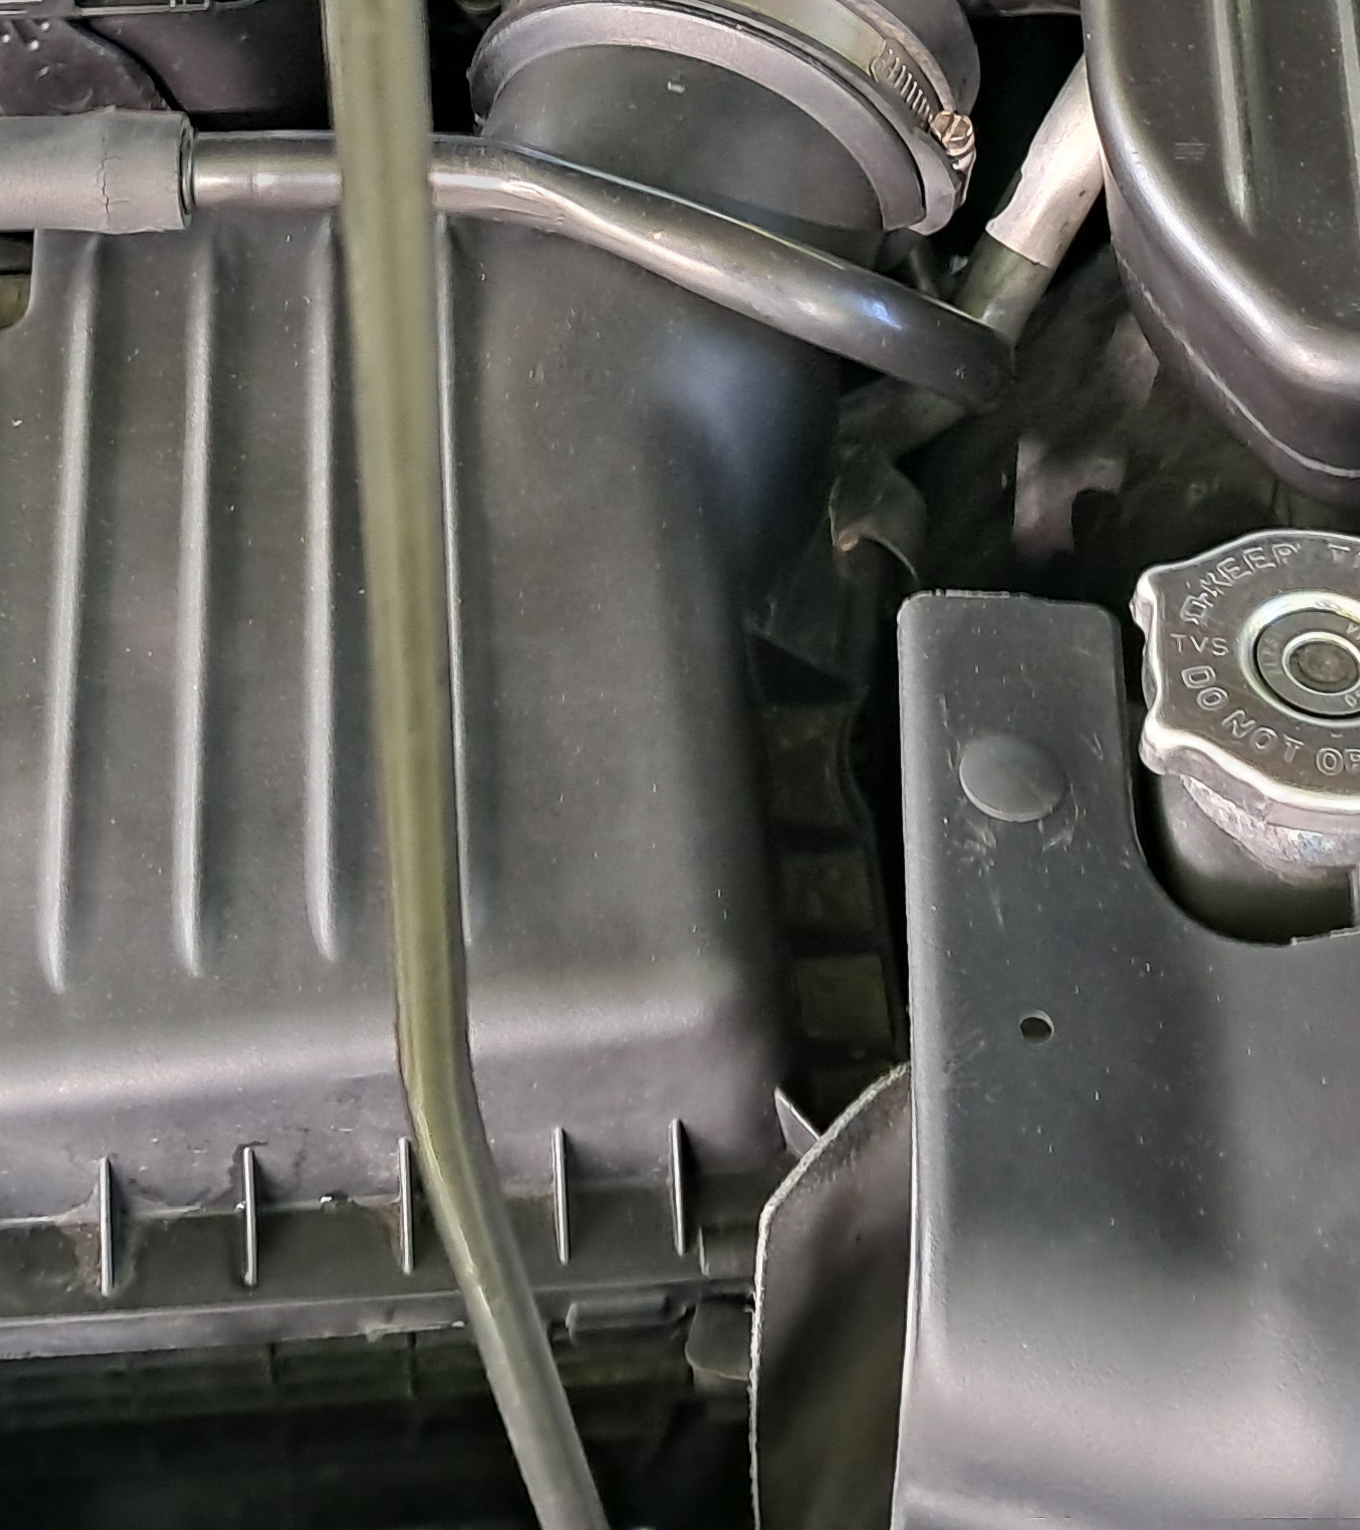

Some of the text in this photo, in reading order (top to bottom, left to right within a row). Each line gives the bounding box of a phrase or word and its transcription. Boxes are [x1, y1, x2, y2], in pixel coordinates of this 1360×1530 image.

[1199, 542, 1300, 597] KEEP
[1169, 632, 1230, 657] TVS
[1180, 664, 1230, 712] DO
[1221, 708, 1305, 764] NOT
